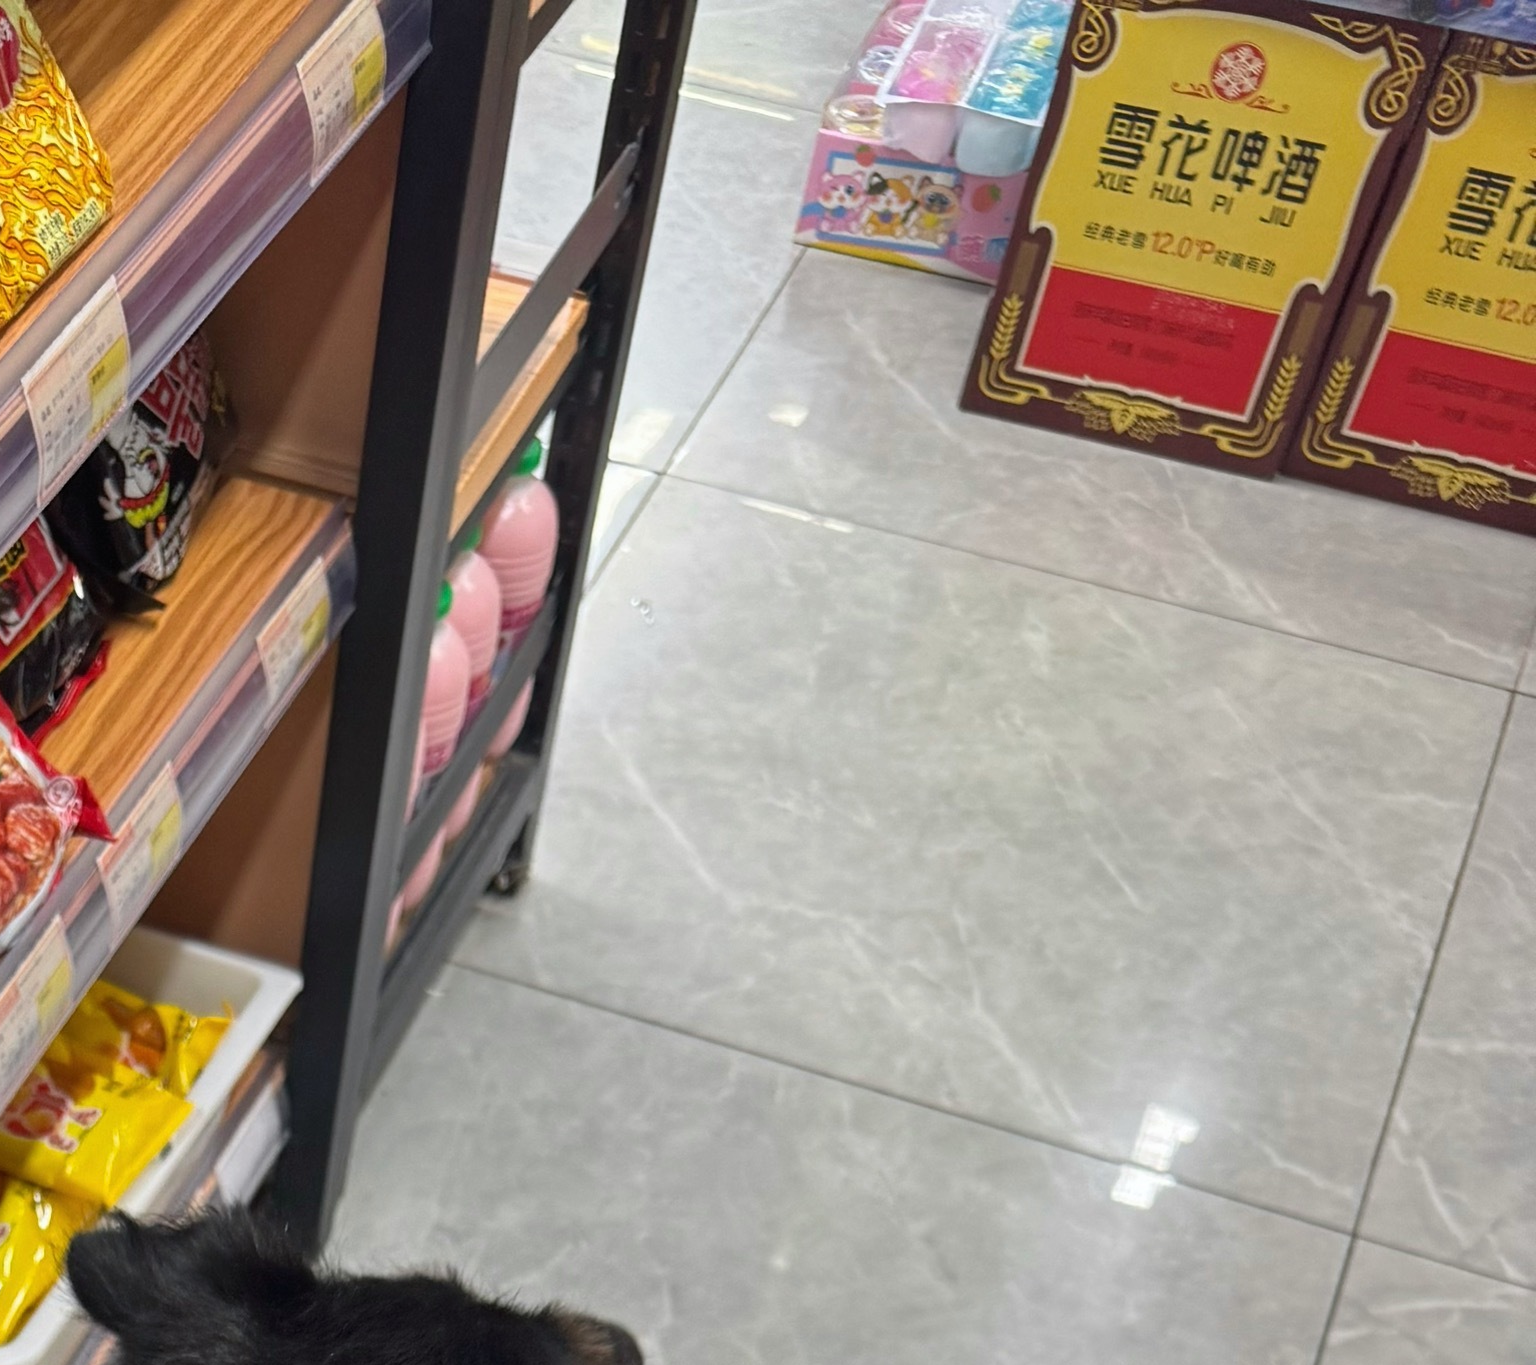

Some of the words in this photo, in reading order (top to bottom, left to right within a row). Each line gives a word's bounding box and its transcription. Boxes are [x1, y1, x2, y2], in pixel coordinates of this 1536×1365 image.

[1098, 101, 1327, 207] 雪花啤酒
[1093, 169, 1136, 197] XUE
[1150, 181, 1194, 208] HUA
[1209, 191, 1234, 216] PI
[1259, 203, 1298, 229] JIU
[1438, 233, 1484, 264] XUE
